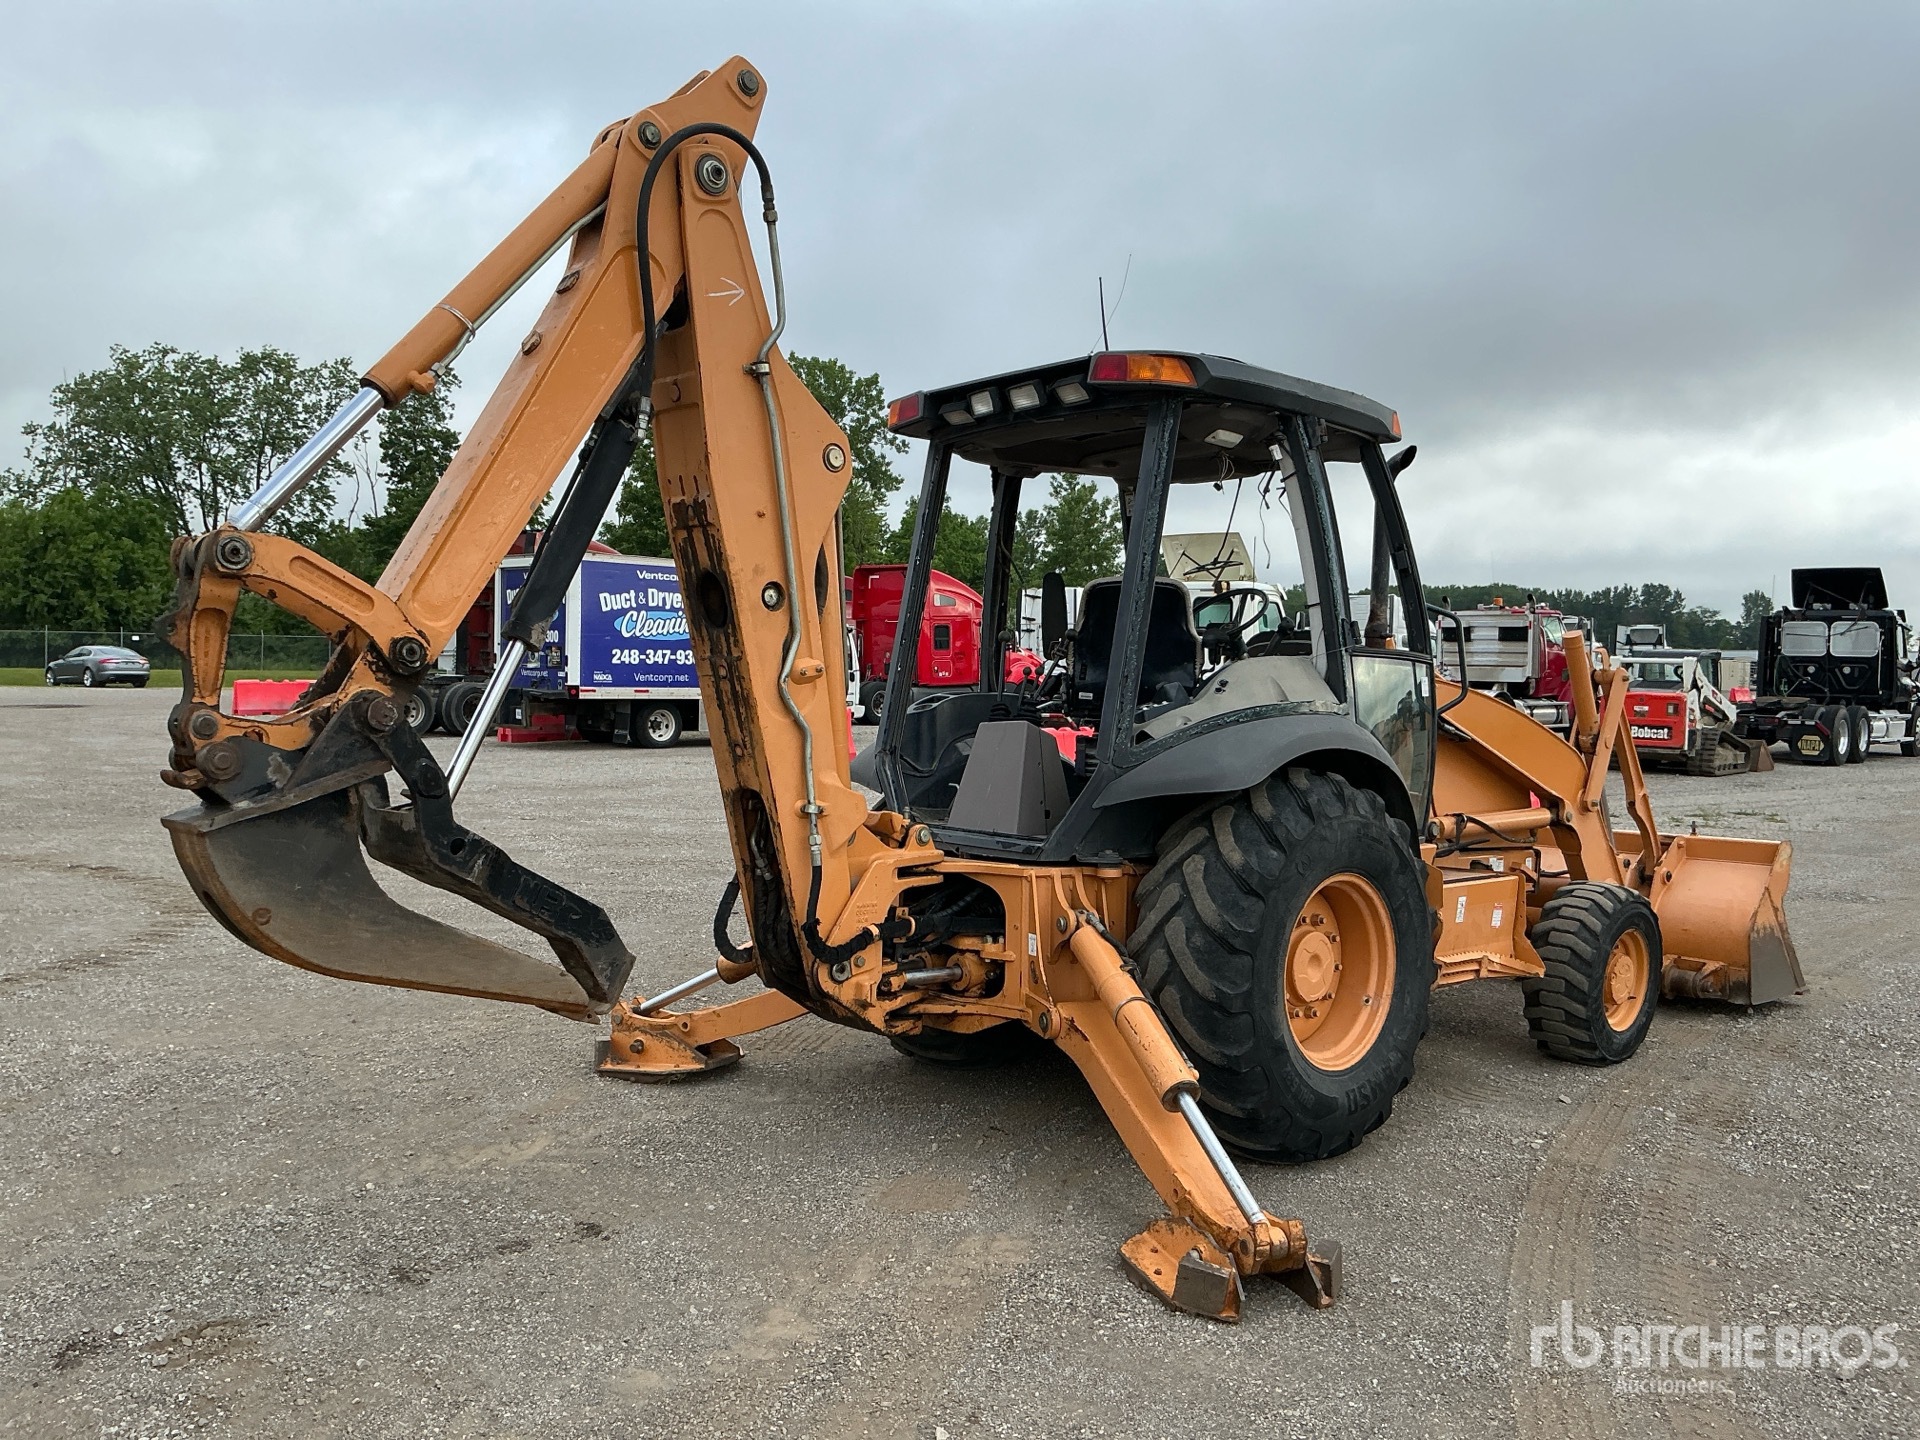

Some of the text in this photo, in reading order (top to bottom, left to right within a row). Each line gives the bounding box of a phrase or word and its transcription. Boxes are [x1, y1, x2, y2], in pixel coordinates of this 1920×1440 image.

[637, 569, 680, 582] Ventco
[599, 589, 637, 612] Duct
[638, 591, 646, 605] &
[611, 648, 696, 666] 248-347-93
[634, 672, 690, 684] Ventcorp.net
[1630, 725, 1670, 740] Bobcat
[1801, 739, 1821, 751] NAPA
